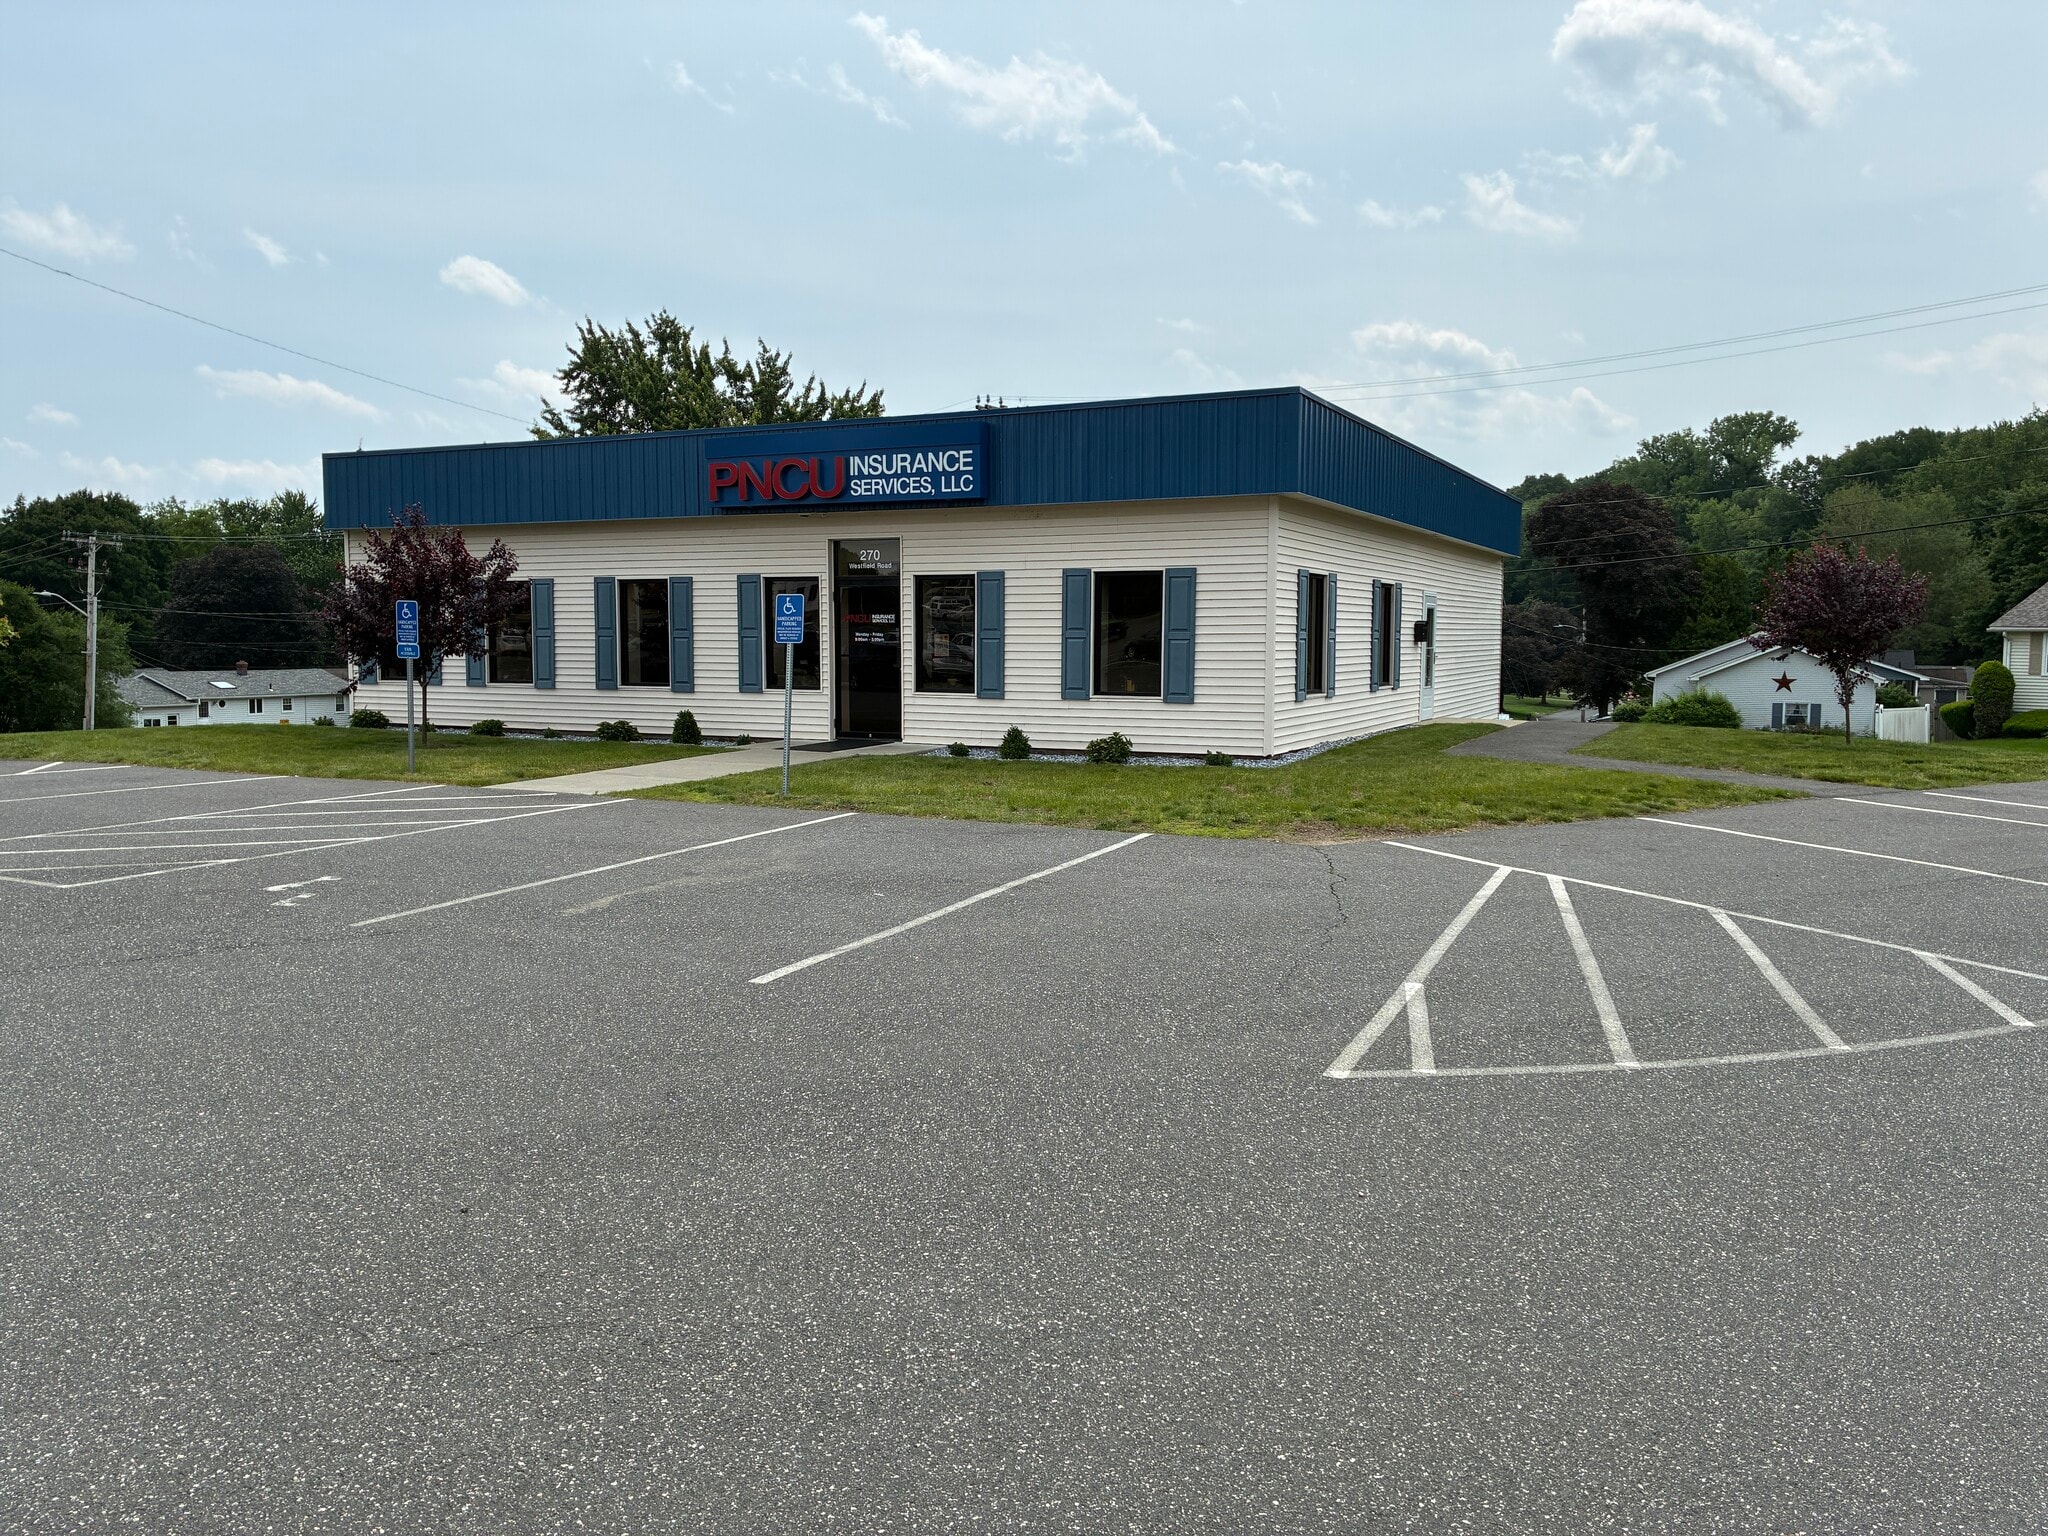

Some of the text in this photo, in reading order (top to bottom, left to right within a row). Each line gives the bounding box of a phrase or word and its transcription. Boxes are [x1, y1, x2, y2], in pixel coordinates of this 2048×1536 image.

[850, 450, 973, 476] INSURANCE
[708, 455, 846, 501] PNCU
[850, 474, 974, 496] SERVICES, LLC
[860, 549, 880, 561] 270
